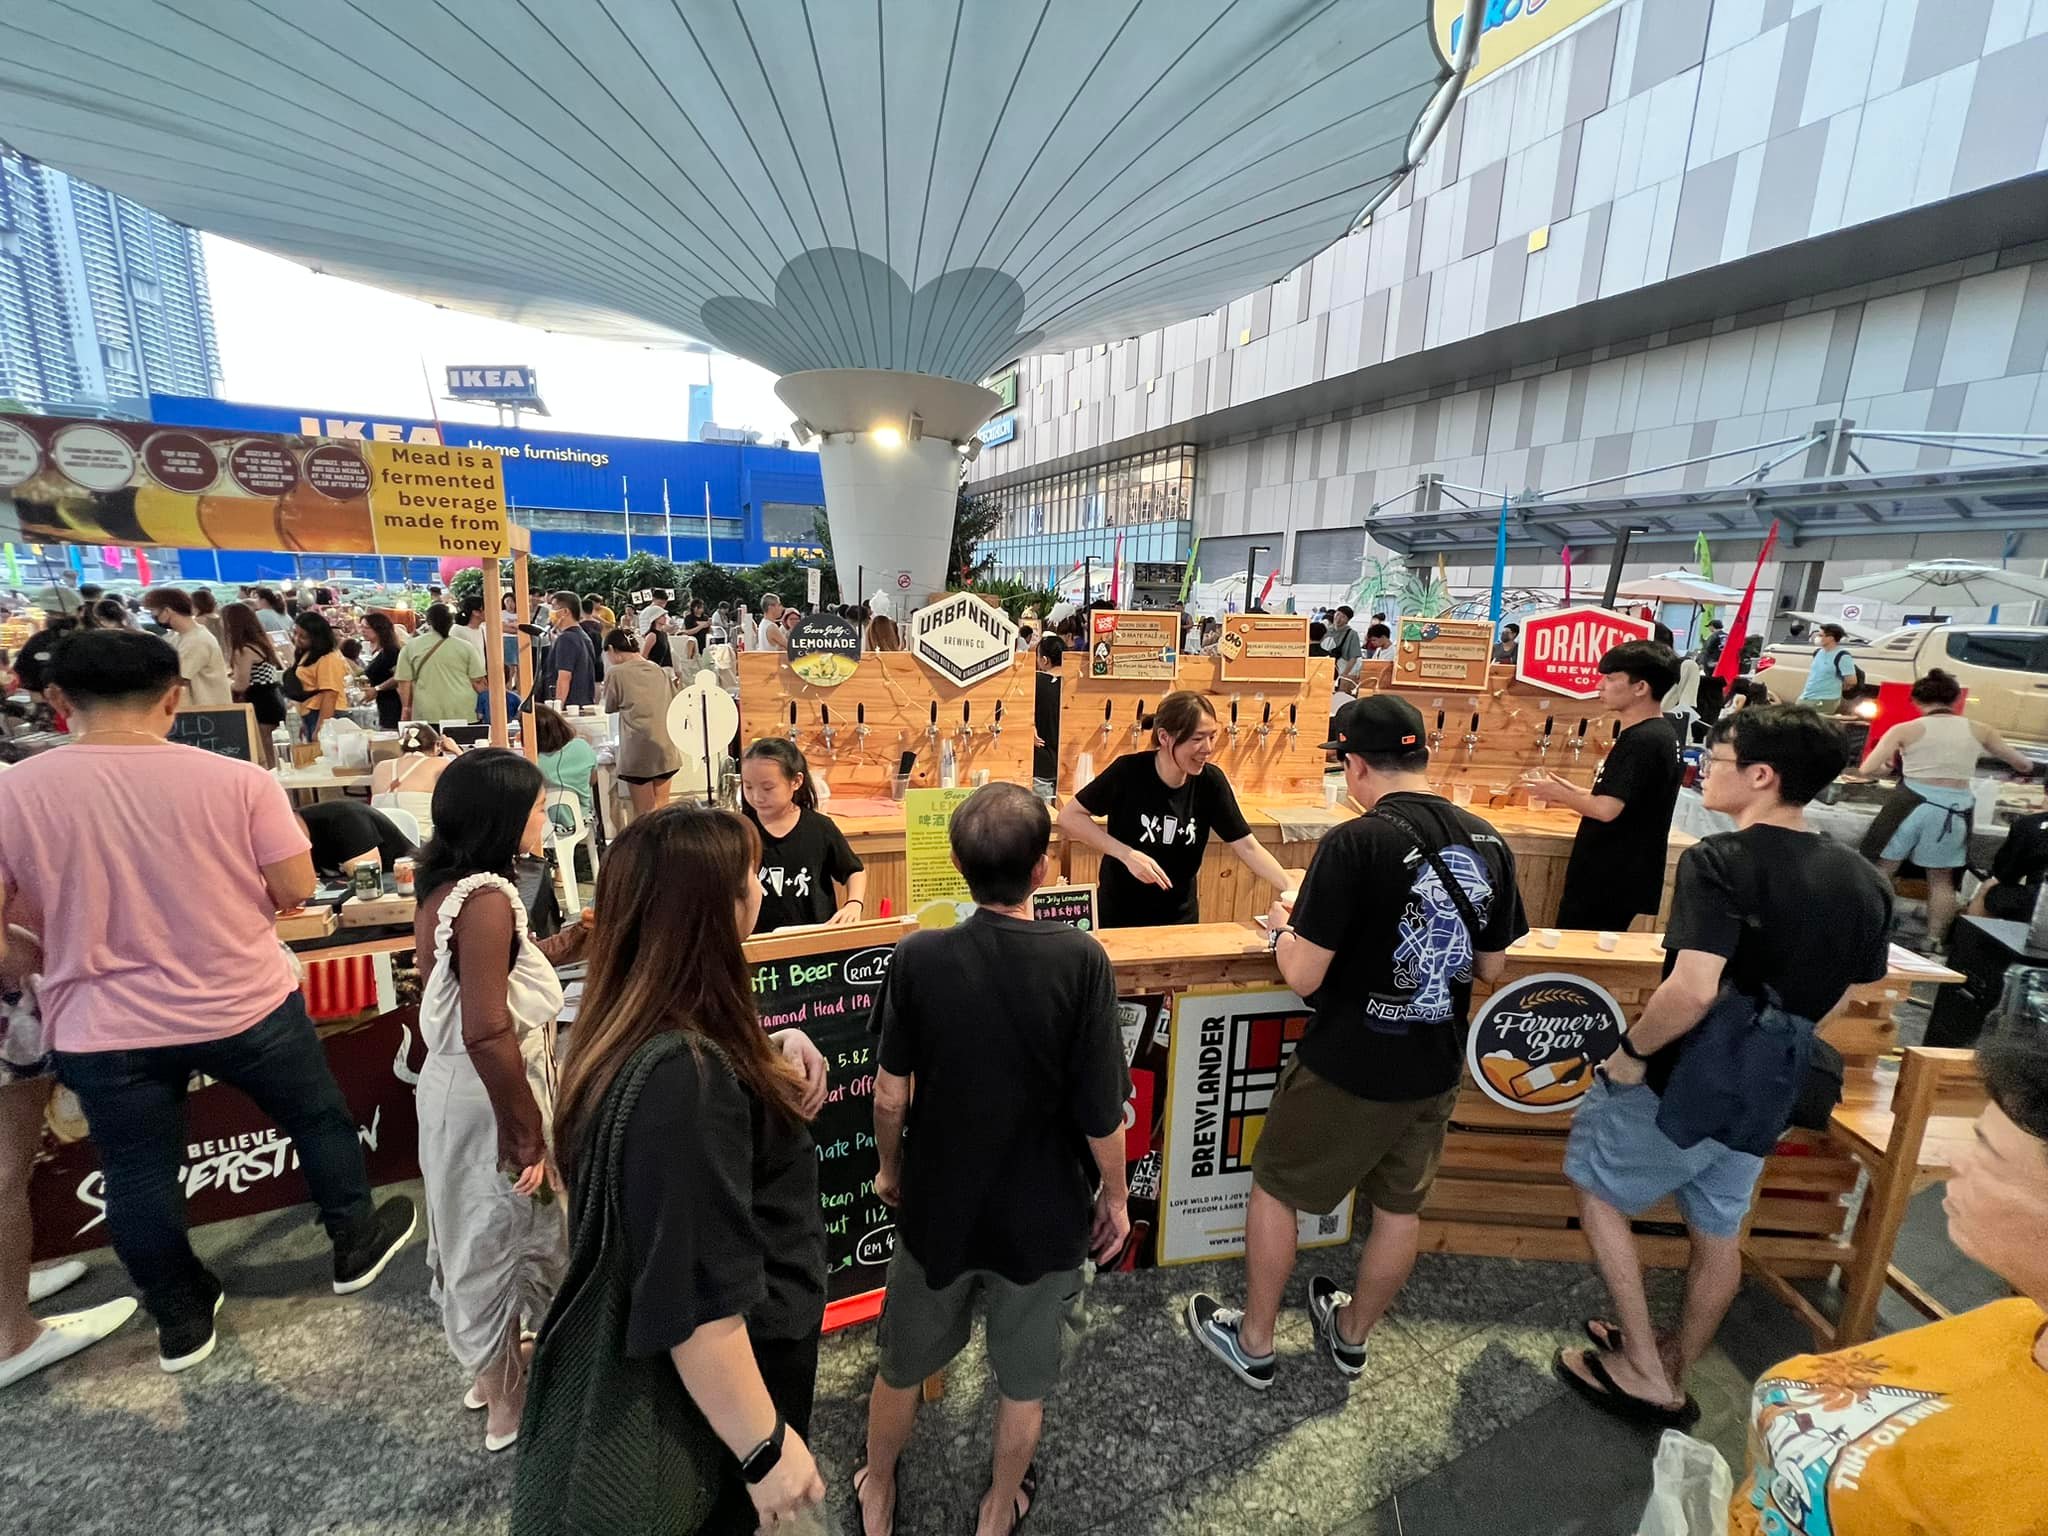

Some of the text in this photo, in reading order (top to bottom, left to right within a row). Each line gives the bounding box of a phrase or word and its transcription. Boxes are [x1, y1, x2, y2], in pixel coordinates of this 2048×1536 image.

[450, 371, 524, 387] IKEA
[300, 417, 441, 445] IKEA
[392, 448, 493, 469] Mead is a
[468, 440, 608, 466] Home furnishings
[382, 468, 495, 489] fermented
[399, 490, 497, 514] beverage
[384, 513, 499, 531] made from
[440, 535, 501, 554] honey
[770, 546, 825, 560] IKEA
[920, 600, 1011, 646] URBANAUT
[792, 639, 856, 648] LEMONADE
[944, 636, 984, 648] BREWING CO
[1546, 664, 1600, 675] BREWI
[919, 814, 950, 826] 啤酒
[790, 963, 838, 986] Beer
[758, 994, 870, 1028] iamond Head IPA
[1493, 1011, 1612, 1039] Farmer's
[1526, 1030, 1585, 1061] Bar
[838, 1048, 869, 1068] 5.8%
[851, 1075, 875, 1097] Off
[187, 1128, 278, 1160] BELIEVE
[861, 1180, 876, 1198] M
[1170, 1198, 1188, 1208] LOVE
[1230, 1193, 1243, 1201] JOY
[1182, 1202, 1244, 1216] FREEDOM LAGER
[866, 1204, 888, 1224] 11%
[864, 1242, 882, 1256] RM
